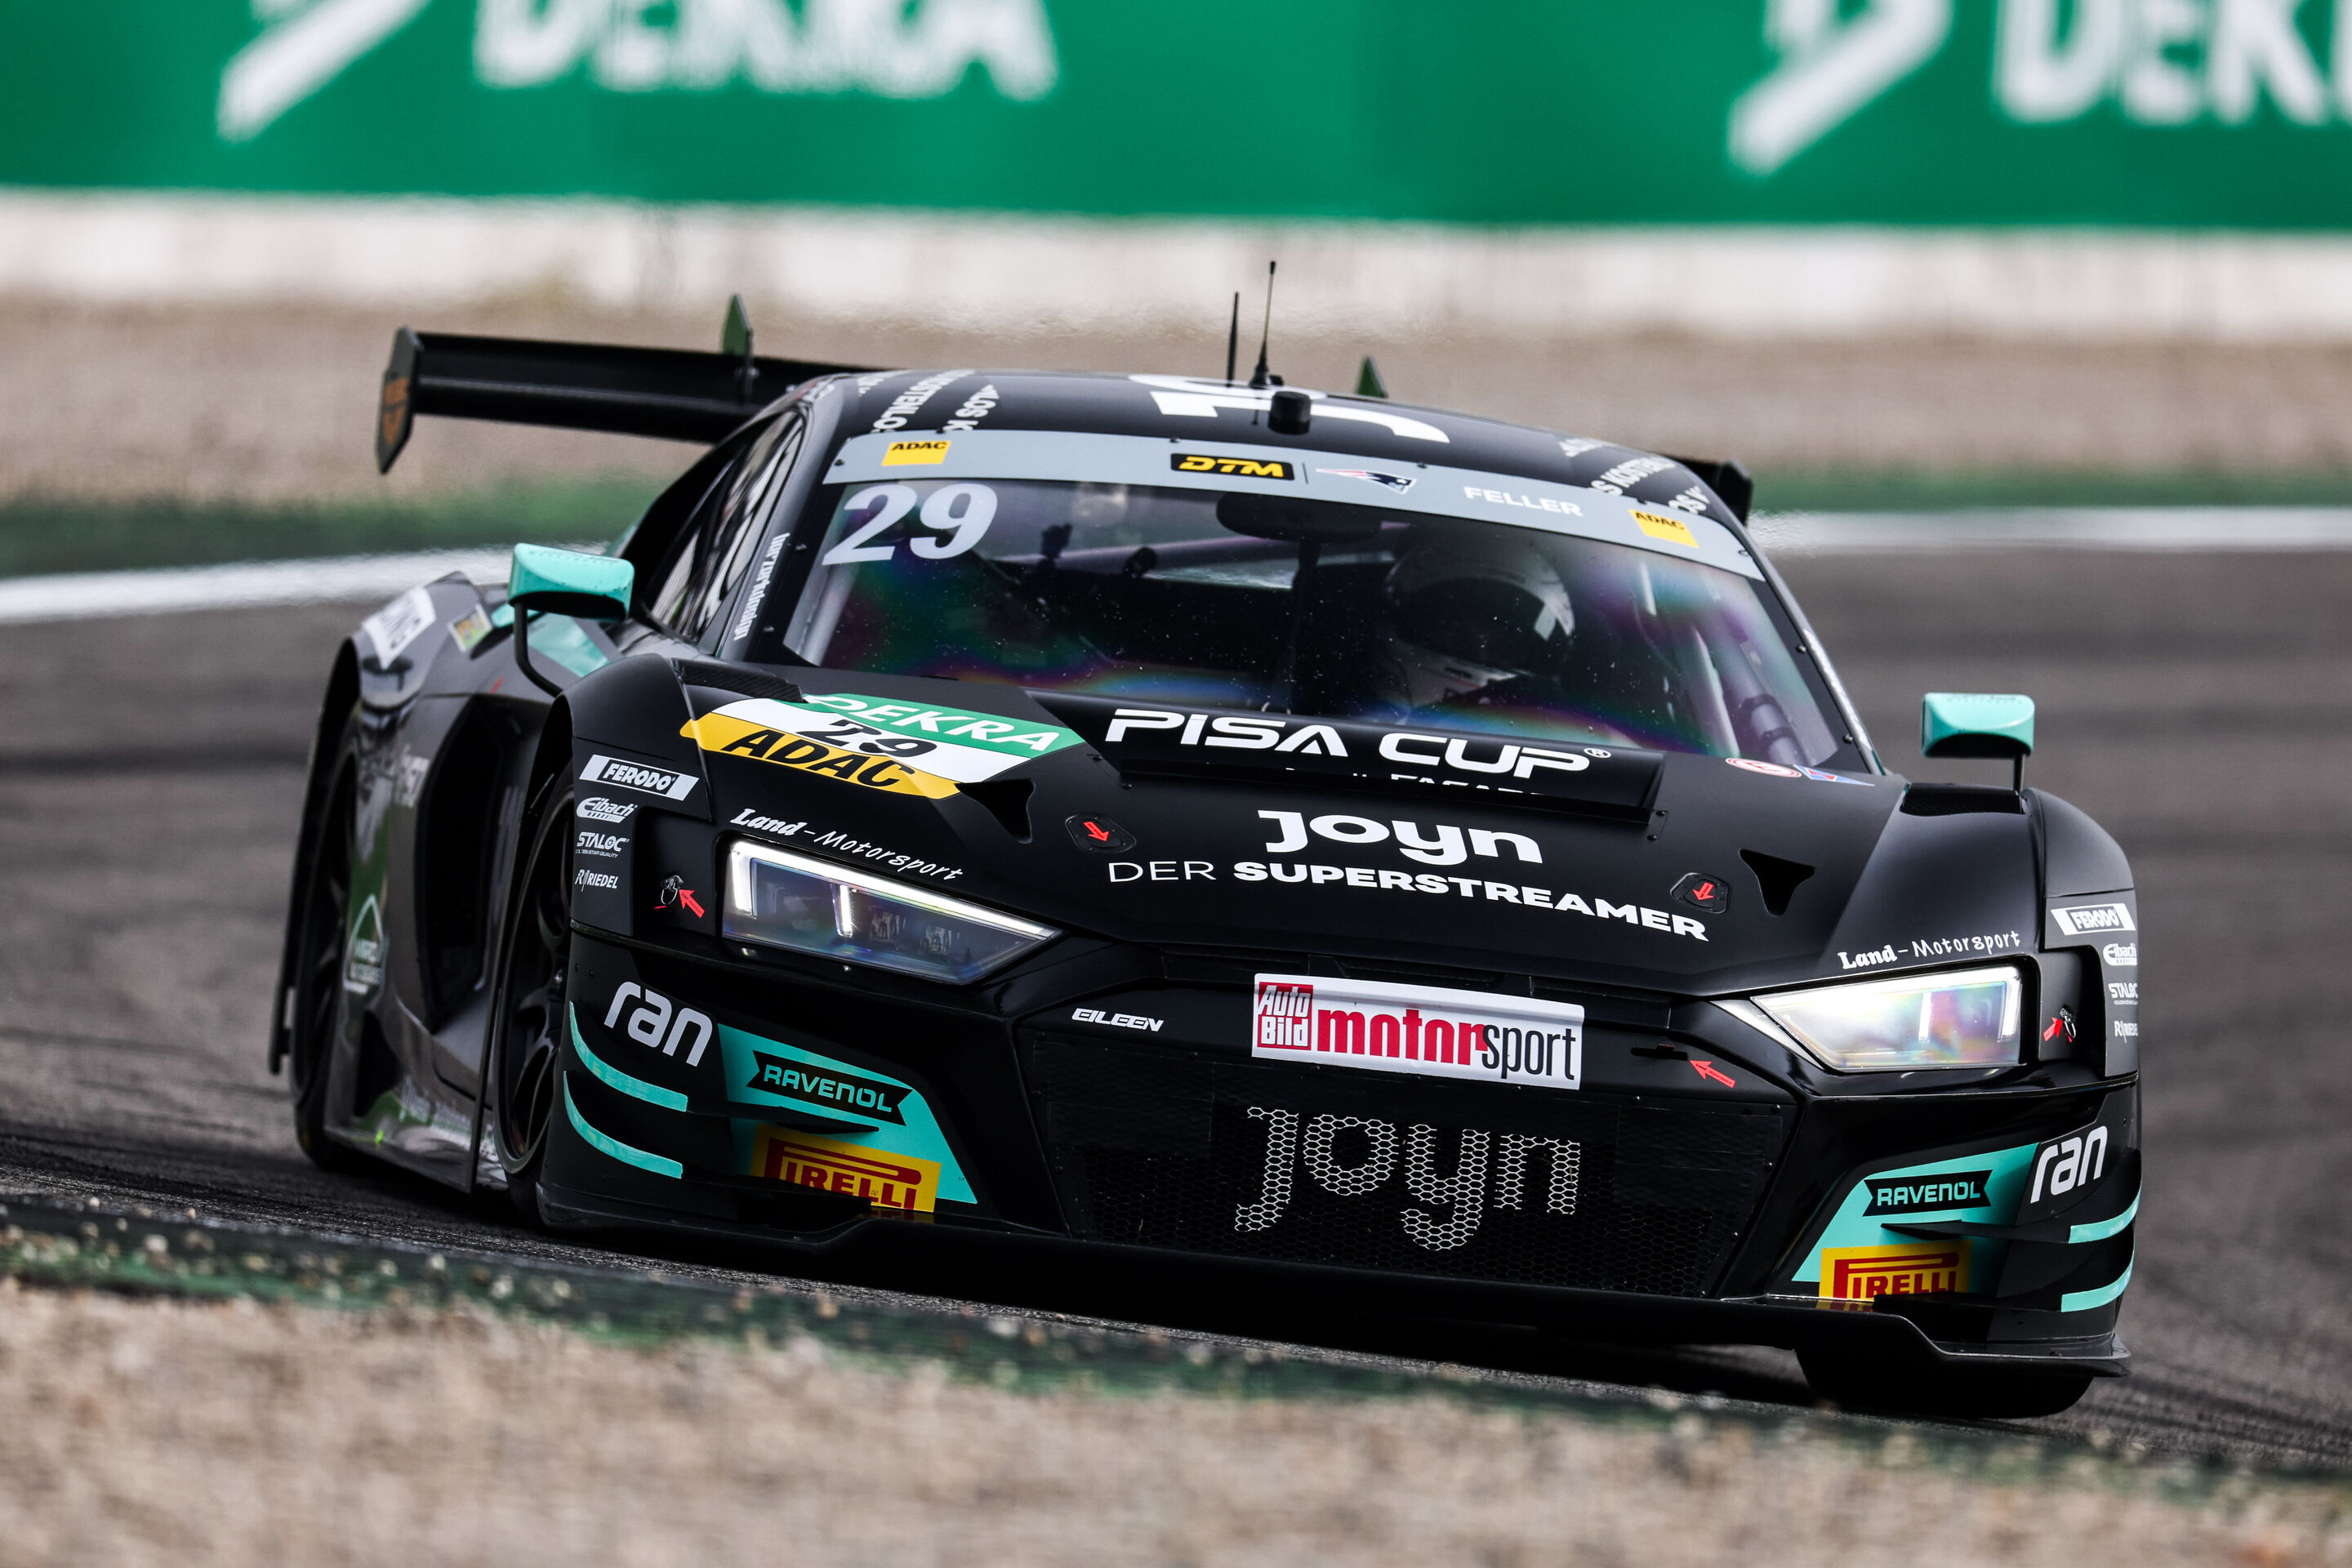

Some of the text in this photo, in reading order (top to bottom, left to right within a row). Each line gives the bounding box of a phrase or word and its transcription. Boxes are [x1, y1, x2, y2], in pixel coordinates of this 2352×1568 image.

[892, 441, 947, 452] ADAC
[1178, 455, 1286, 479] DTM
[1464, 486, 1584, 518] FELLER
[822, 483, 998, 565] 29
[1635, 511, 1685, 531] ADAC
[804, 694, 1060, 752] DEKRA
[1104, 708, 1349, 758] PISA
[723, 729, 915, 788] ADAC
[602, 764, 675, 791] FERODO
[576, 796, 638, 823] Eibach
[576, 831, 630, 853] STALOC
[1108, 860, 1710, 943] DER SUPERSTREAMER
[2069, 908, 2120, 929] FERODO
[1258, 985, 1312, 1018] Auto
[604, 981, 714, 1067] ran
[1071, 1008, 1165, 1032] EILEEN
[1260, 1015, 1309, 1047] Bild
[763, 1063, 893, 1113] RAVENOL
[764, 1138, 922, 1211] PIRELLI
[2029, 1125, 2109, 1205] ran
[1877, 1180, 1982, 1207] RAVENOL
[1832, 1251, 1960, 1300] PIRELLI
